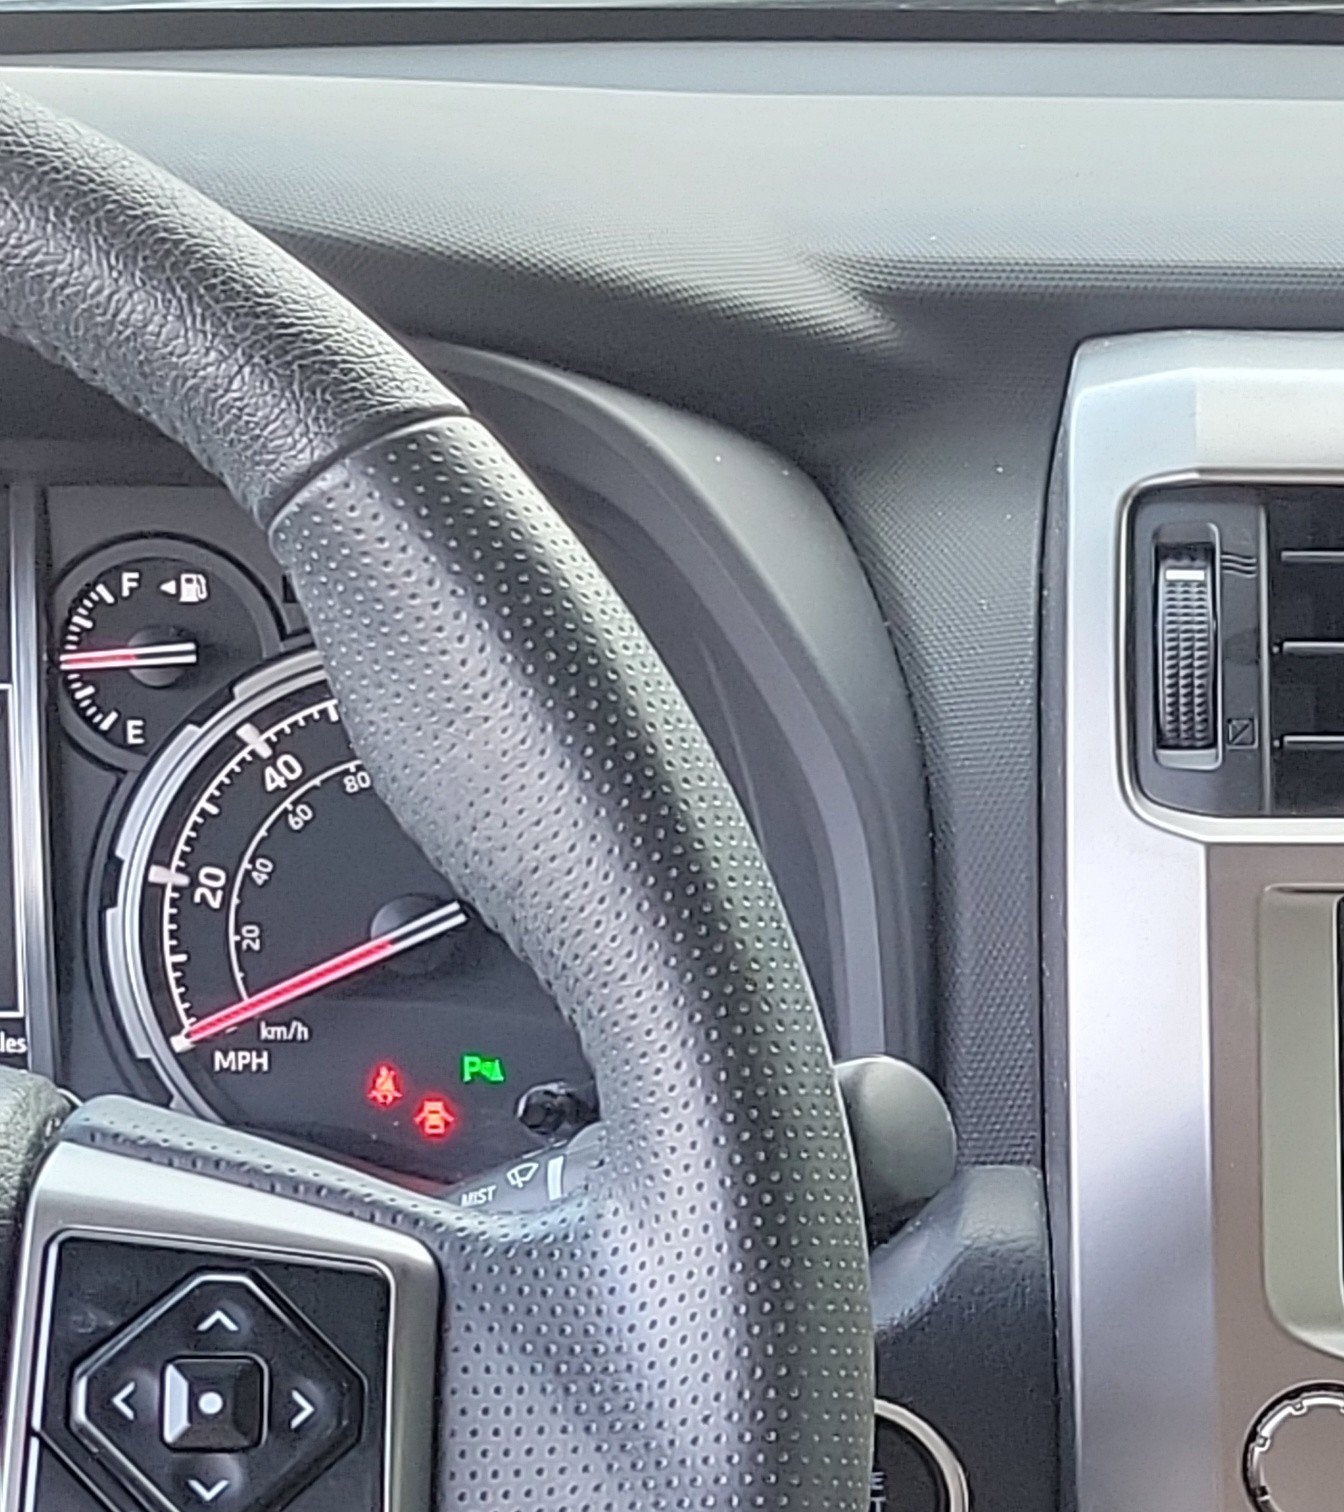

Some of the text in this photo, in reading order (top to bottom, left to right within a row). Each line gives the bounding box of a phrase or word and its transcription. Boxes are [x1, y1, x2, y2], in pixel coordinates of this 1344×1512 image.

[121, 571, 140, 597] F
[126, 719, 145, 744] E
[263, 756, 303, 793] 40
[343, 771, 372, 793] 80
[288, 804, 314, 830] 60
[250, 858, 274, 885] 40
[195, 866, 226, 909] 20
[242, 925, 260, 951] 20
[260, 1020, 309, 1041] km/h
[214, 1050, 269, 1072] MPH
